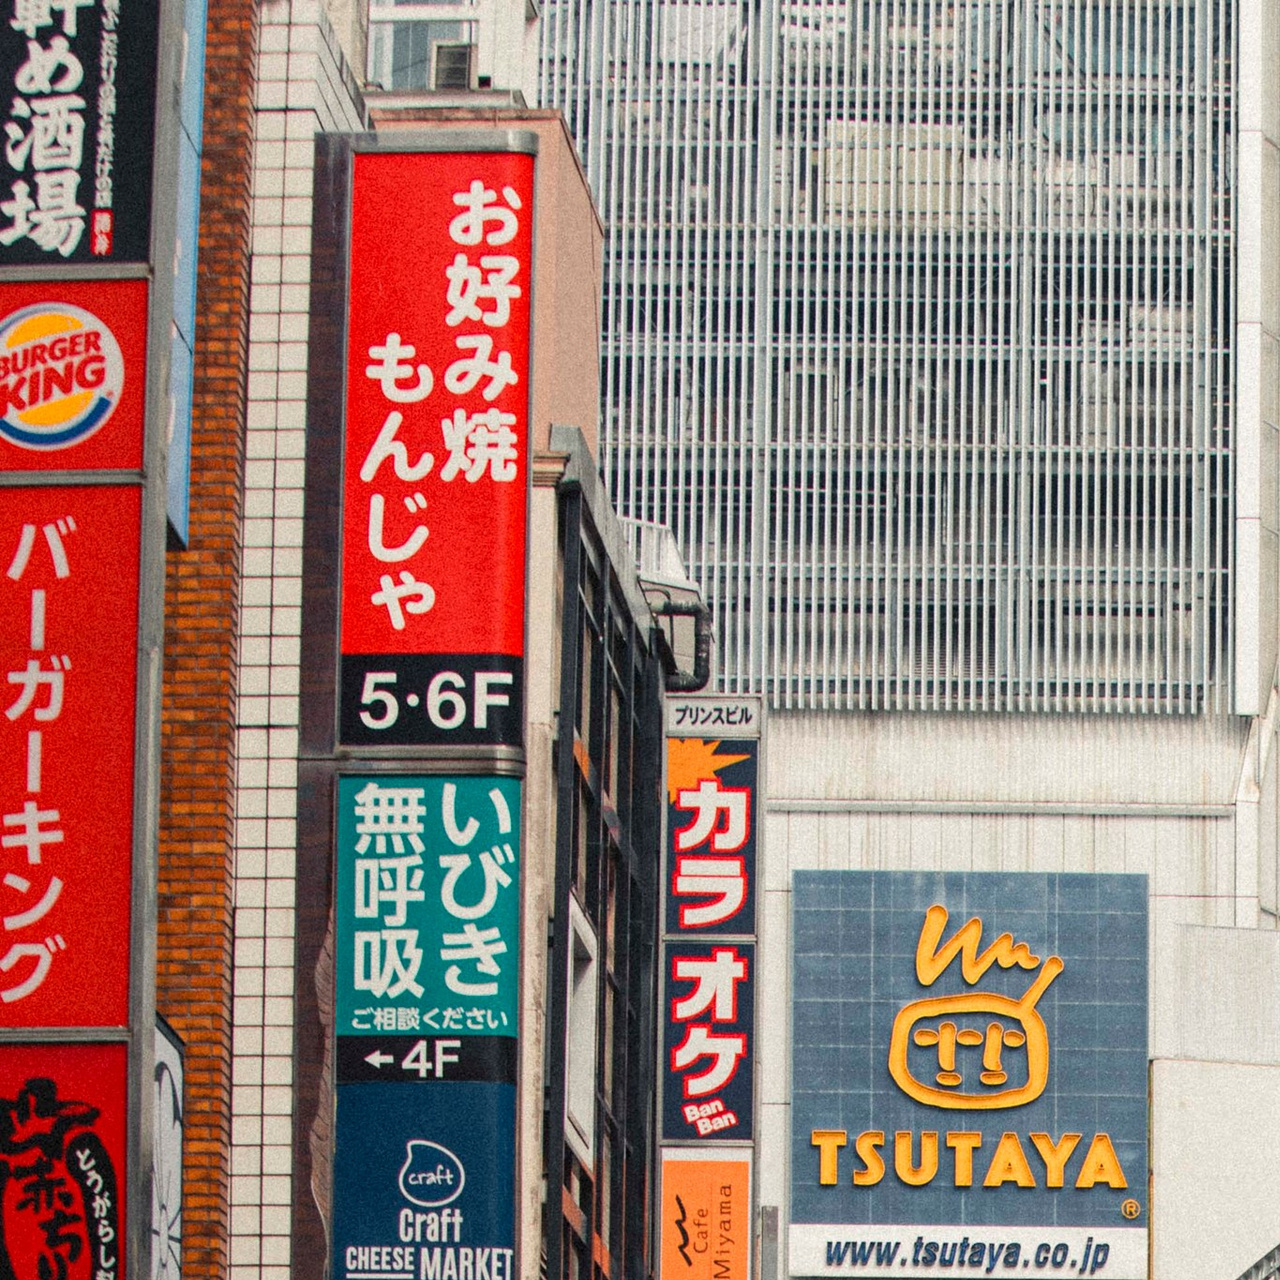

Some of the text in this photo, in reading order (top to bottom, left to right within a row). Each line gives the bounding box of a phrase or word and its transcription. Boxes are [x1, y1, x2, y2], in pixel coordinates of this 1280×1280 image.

[440, 180, 522, 482] お好み焼
[360, 331, 435, 631] もんじゃ
[675, 705, 753, 726] プリンスビル
[0, 514, 77, 1001] バーガーキング
[353, 783, 425, 999] 無呼吸
[440, 783, 515, 998] いびき
[674, 780, 751, 1096] カラオケ
[350, 1006, 509, 1031] ご相談ください
[401, 1039, 462, 1079] 4F
[683, 1099, 724, 1122] Ban
[695, 1112, 737, 1137] Ban
[408, 1164, 454, 1185] craft
[810, 1130, 1130, 1189] TSUTAYA
[400, 1208, 463, 1242] Craft
[693, 1208, 709, 1254] Cafe
[713, 1184, 735, 1280] Miyama
[346, 1246, 415, 1270] CHEESE
[825, 1236, 1110, 1276] www.tsutaya.co.jp
